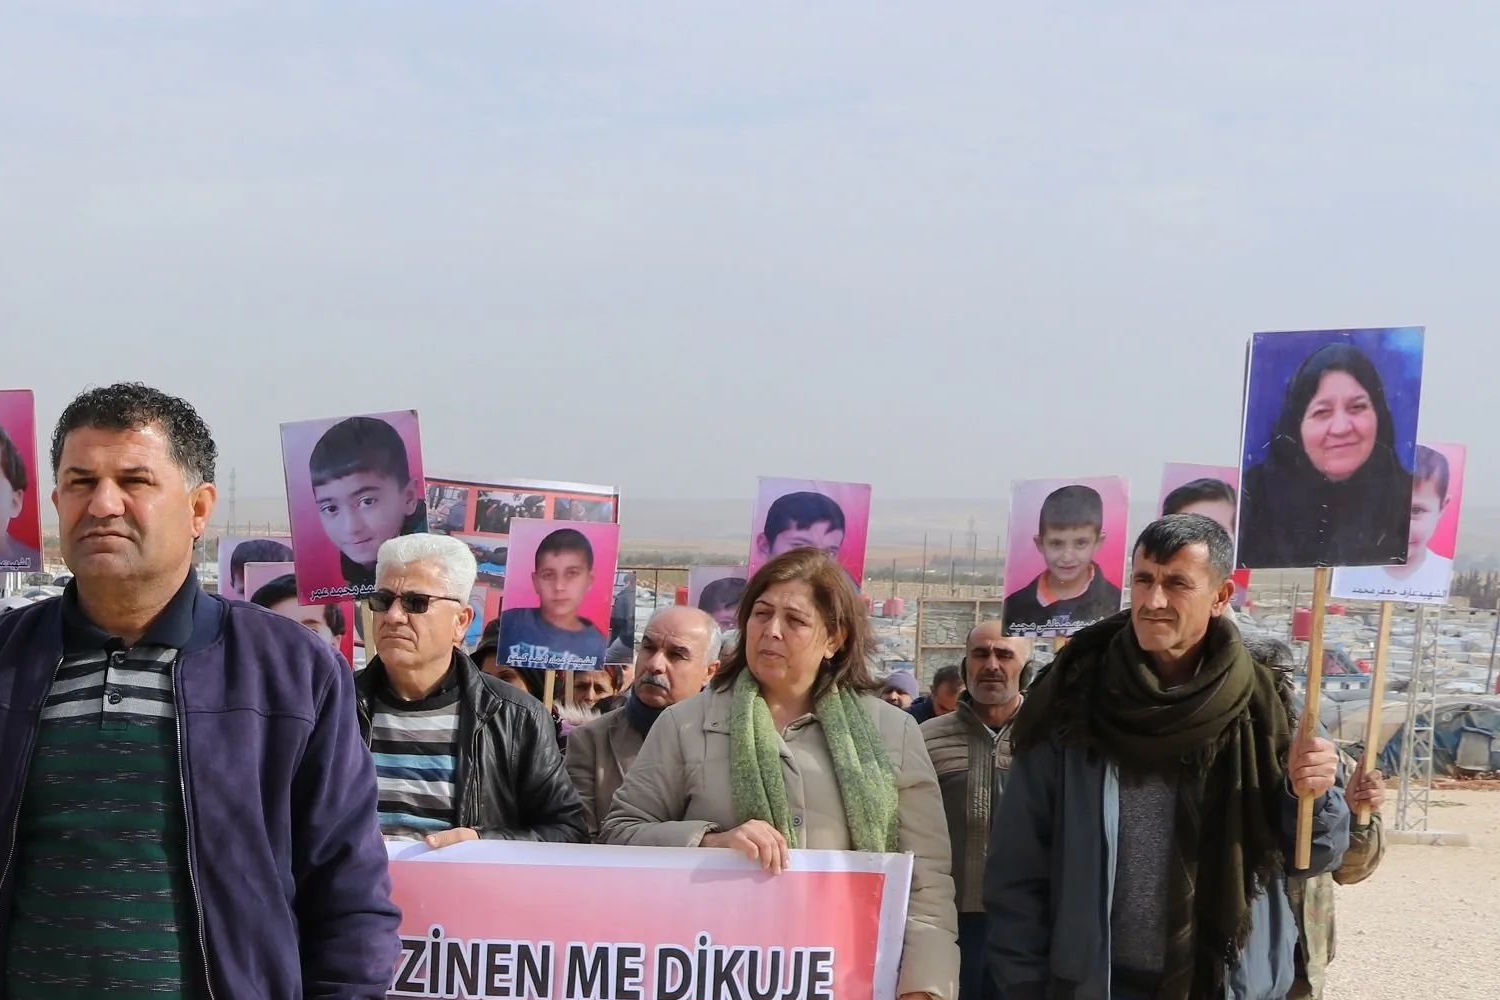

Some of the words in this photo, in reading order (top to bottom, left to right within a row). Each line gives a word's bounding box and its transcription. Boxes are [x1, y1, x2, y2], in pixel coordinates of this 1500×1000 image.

[310, 587, 330, 601] عمر
[330, 585, 359, 597] محمد
[1009, 622, 1037, 632] مجيد
[388, 927, 550, 998] ZİNEN
[565, 945, 642, 1000] ME
